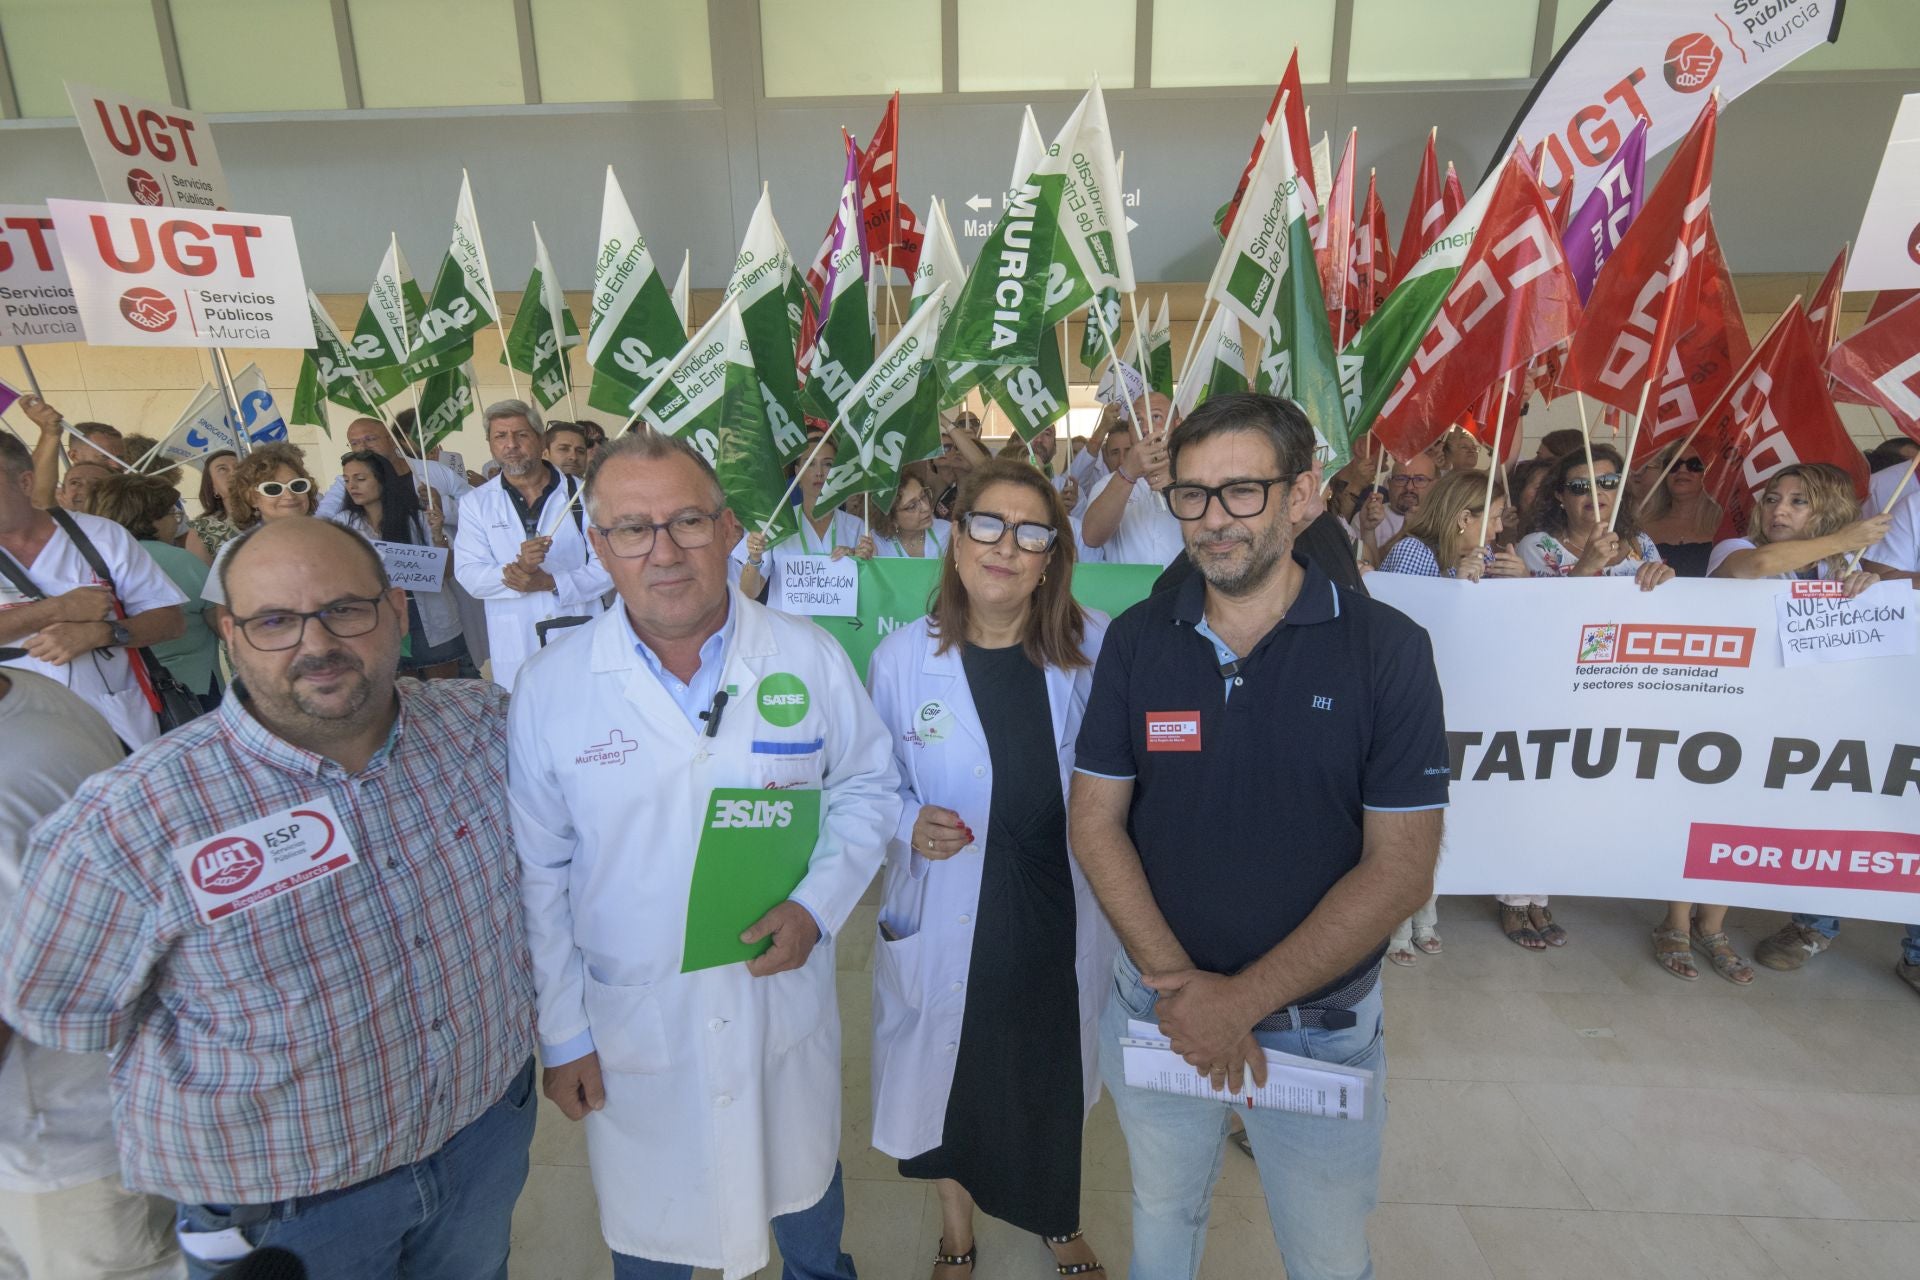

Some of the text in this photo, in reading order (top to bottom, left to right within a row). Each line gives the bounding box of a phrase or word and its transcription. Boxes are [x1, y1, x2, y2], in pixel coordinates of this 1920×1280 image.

[1753, 3, 1820, 53] Murcia
[93, 98, 198, 167] UGT
[1534, 67, 1654, 201] UGT
[172, 175, 213, 191] Servicios
[177, 190, 215, 207] Públicos
[1250, 182, 1286, 259] Sindicato
[90, 215, 262, 278] UGT
[991, 182, 1042, 351] MURCIA
[1269, 250, 1282, 274] de
[0, 287, 74, 300] Servicios
[199, 290, 275, 305] Servicios
[598, 288, 615, 311] de
[1250, 273, 1272, 312] SATSE
[6, 303, 78, 318] Públicos
[204, 308, 274, 321] Públicos
[12, 322, 77, 335] Murcia
[208, 325, 270, 340] Murcia
[672, 341, 725, 384] Sindicato
[865, 336, 919, 398] Sindicato
[686, 383, 704, 399] de
[877, 391, 894, 408] de
[658, 394, 686, 418] SATSE
[387, 572, 437, 584] VANZAR
[786, 561, 826, 576] NUEVA
[786, 575, 854, 589] CLASIFICACIÓN
[786, 591, 841, 605] RETRIBUIDA
[1787, 597, 1853, 618] NUEVA
[1787, 606, 1905, 633] CLASIFICACIÓN
[1626, 632, 1744, 659] CCOO
[1788, 629, 1885, 653] RETRIBUIDA
[1576, 664, 1719, 678] federación de sanidad
[1573, 680, 1744, 694] y sectores sociosanitarios
[763, 694, 805, 705] SATSE
[1152, 724, 1182, 732] CCOO
[575, 750, 621, 765] Murciano
[1448, 727, 1743, 784] TATUTO
[1764, 737, 1920, 797] PAR
[712, 799, 794, 828] SATSE
[198, 840, 252, 877] UGT
[1710, 843, 1920, 876] POR UN EST
[231, 864, 330, 910] Región de Murcia
